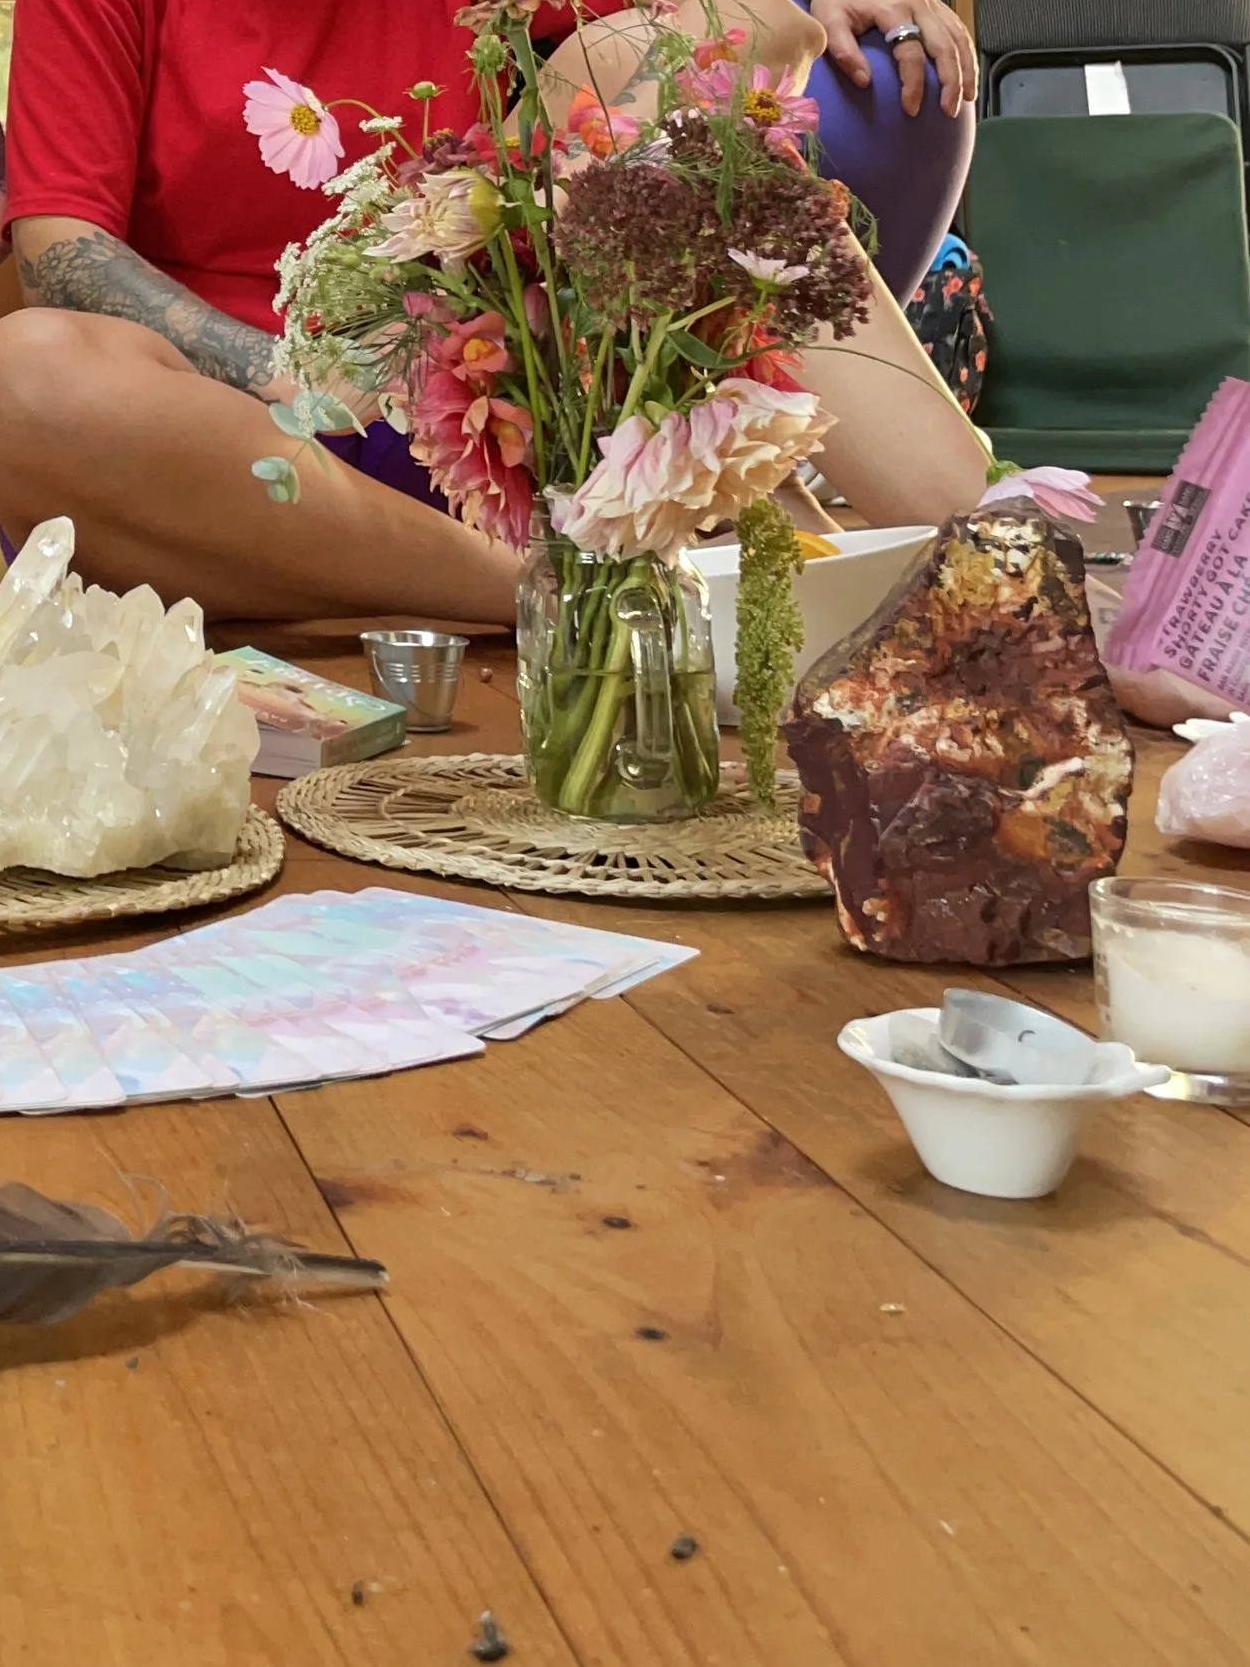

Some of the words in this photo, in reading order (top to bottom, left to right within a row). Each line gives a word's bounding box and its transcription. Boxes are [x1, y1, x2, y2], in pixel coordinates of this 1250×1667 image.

[1227, 555, 1248, 578] LA
[1164, 584, 1208, 659] SHORTY
[1206, 542, 1229, 583] GOT
[1197, 616, 1239, 682] FRAISE
